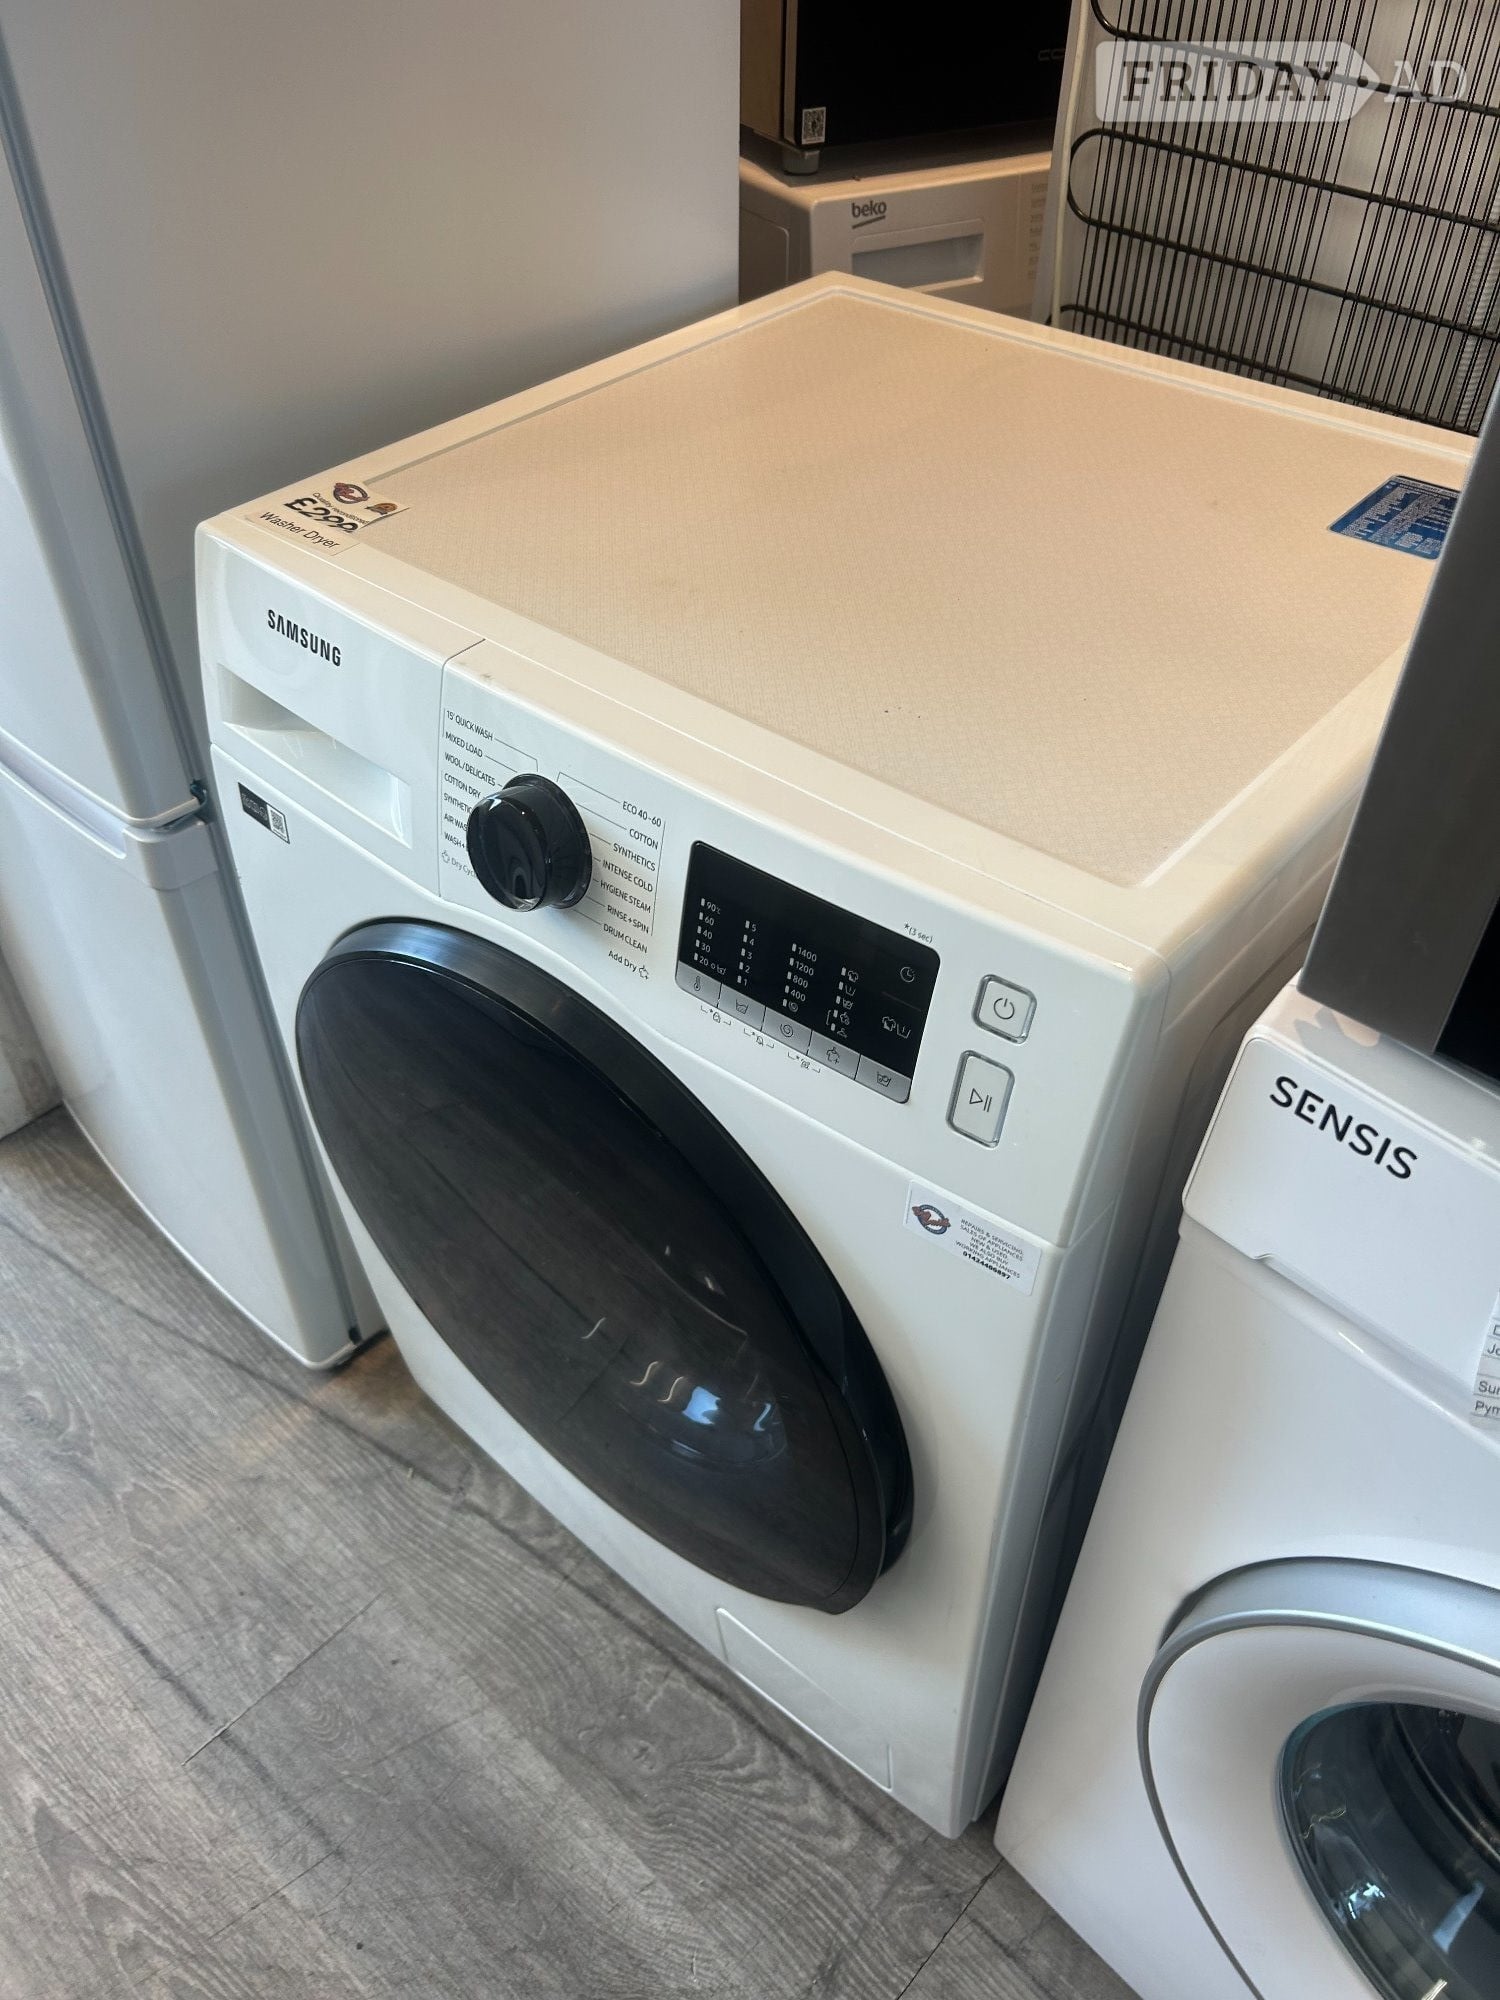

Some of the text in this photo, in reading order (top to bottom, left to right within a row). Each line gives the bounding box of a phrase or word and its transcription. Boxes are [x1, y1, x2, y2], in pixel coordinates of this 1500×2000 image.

[851, 200, 887, 218] beko
[283, 497, 359, 533] £299
[260, 511, 340, 548] Washer Dryer
[267, 609, 342, 667] SAMSUNG
[455, 715, 475, 732] QUICK
[474, 726, 493, 741] WASH
[445, 731, 483, 758] MIXED LOAD
[444, 773, 481, 799] COTTON DRY
[443, 792, 473, 814] SYNTHETIC
[623, 801, 638, 815] ECO
[444, 813, 468, 832] AIR WAS
[444, 832, 466, 849] WASH+
[629, 828, 658, 850] COTTON
[613, 842, 656, 872] SYNTHETICS
[451, 857, 477, 878] Dry Cyc
[602, 859, 653, 893] INTENSE COLD
[600, 879, 651, 914] HYGIENE STEAM
[704, 916, 715, 926] 60
[751, 924, 757, 932] 5
[603, 923, 647, 954] DRUM CLEAN
[702, 929, 713, 940] 40
[749, 938, 755, 946] 4
[917, 932, 933, 944] sec)
[701, 943, 711, 953] 30
[747, 951, 753, 960] 3
[798, 946, 817, 962] 1400
[608, 950, 637, 973] Add Dry
[699, 956, 709, 966] 20
[745, 965, 751, 974] 2
[795, 961, 814, 976] 1200
[792, 975, 808, 989] 800
[790, 989, 806, 1002] 400
[1269, 1076, 1418, 1179] SENSIS
[961, 1219, 984, 1234] REPAIRS
[960, 1225, 977, 1237] SALES
[987, 1240, 1023, 1262] APPLIANCES
[971, 1237, 985, 1247] NEW
[970, 1242, 1009, 1265] WE ALSO BUY
[985, 1257, 1020, 1278] APPLIANCES
